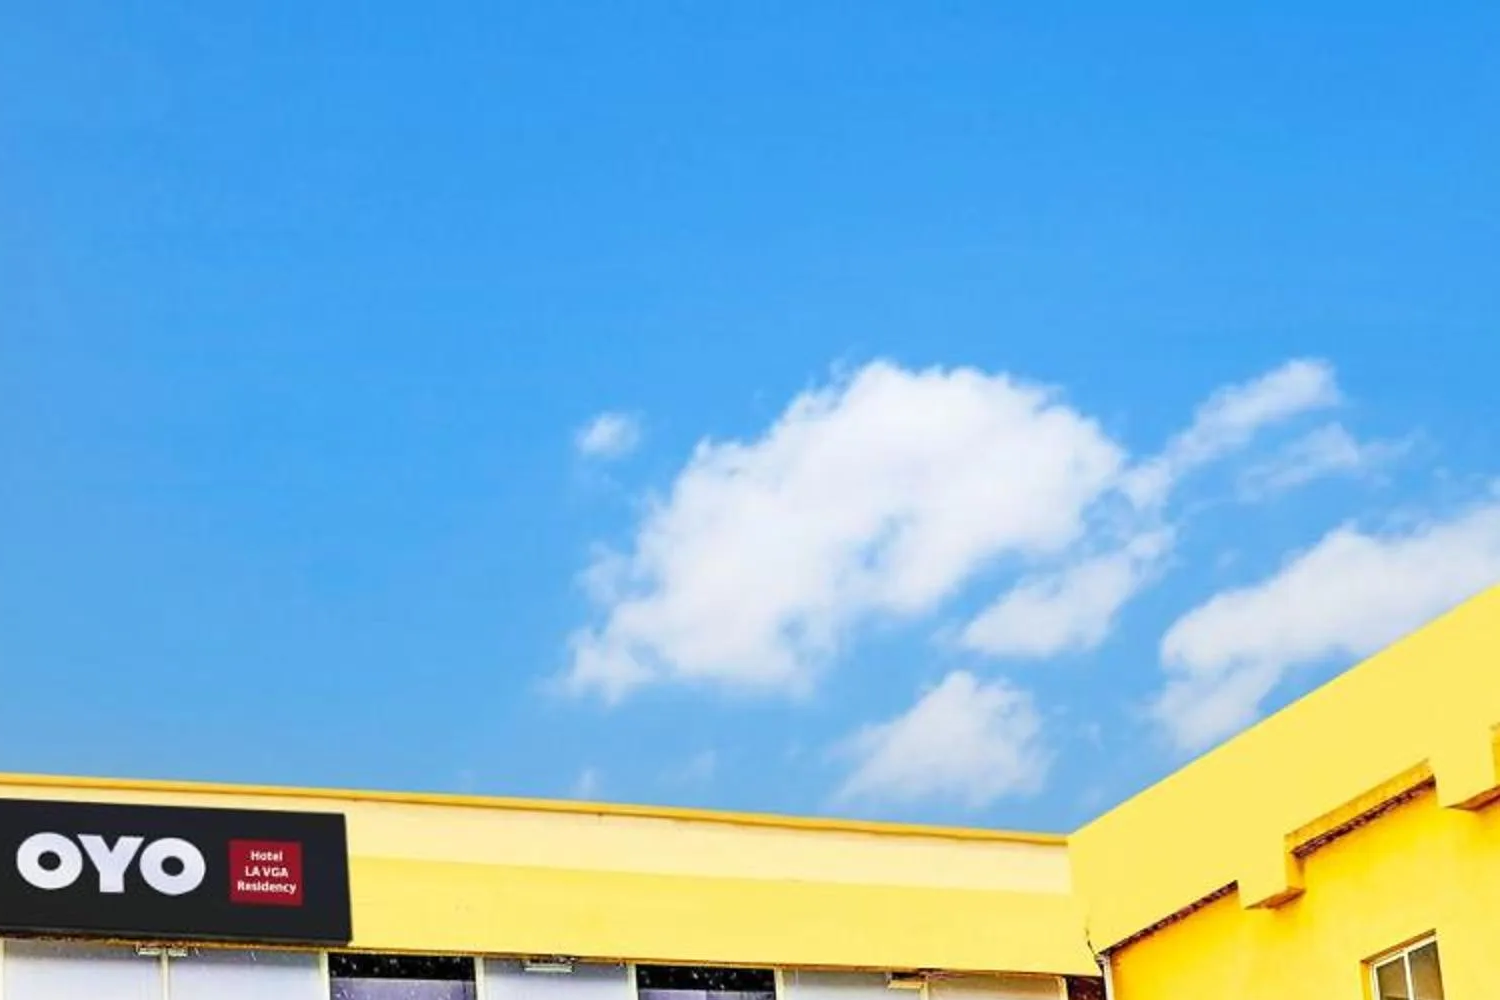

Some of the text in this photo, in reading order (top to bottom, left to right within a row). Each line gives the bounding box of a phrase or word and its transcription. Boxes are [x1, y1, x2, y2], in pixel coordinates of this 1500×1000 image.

[250, 850, 283, 861] Hotel
[16, 831, 206, 895] OYO
[245, 866, 289, 878] LA VGA
[236, 880, 297, 895] Residency
